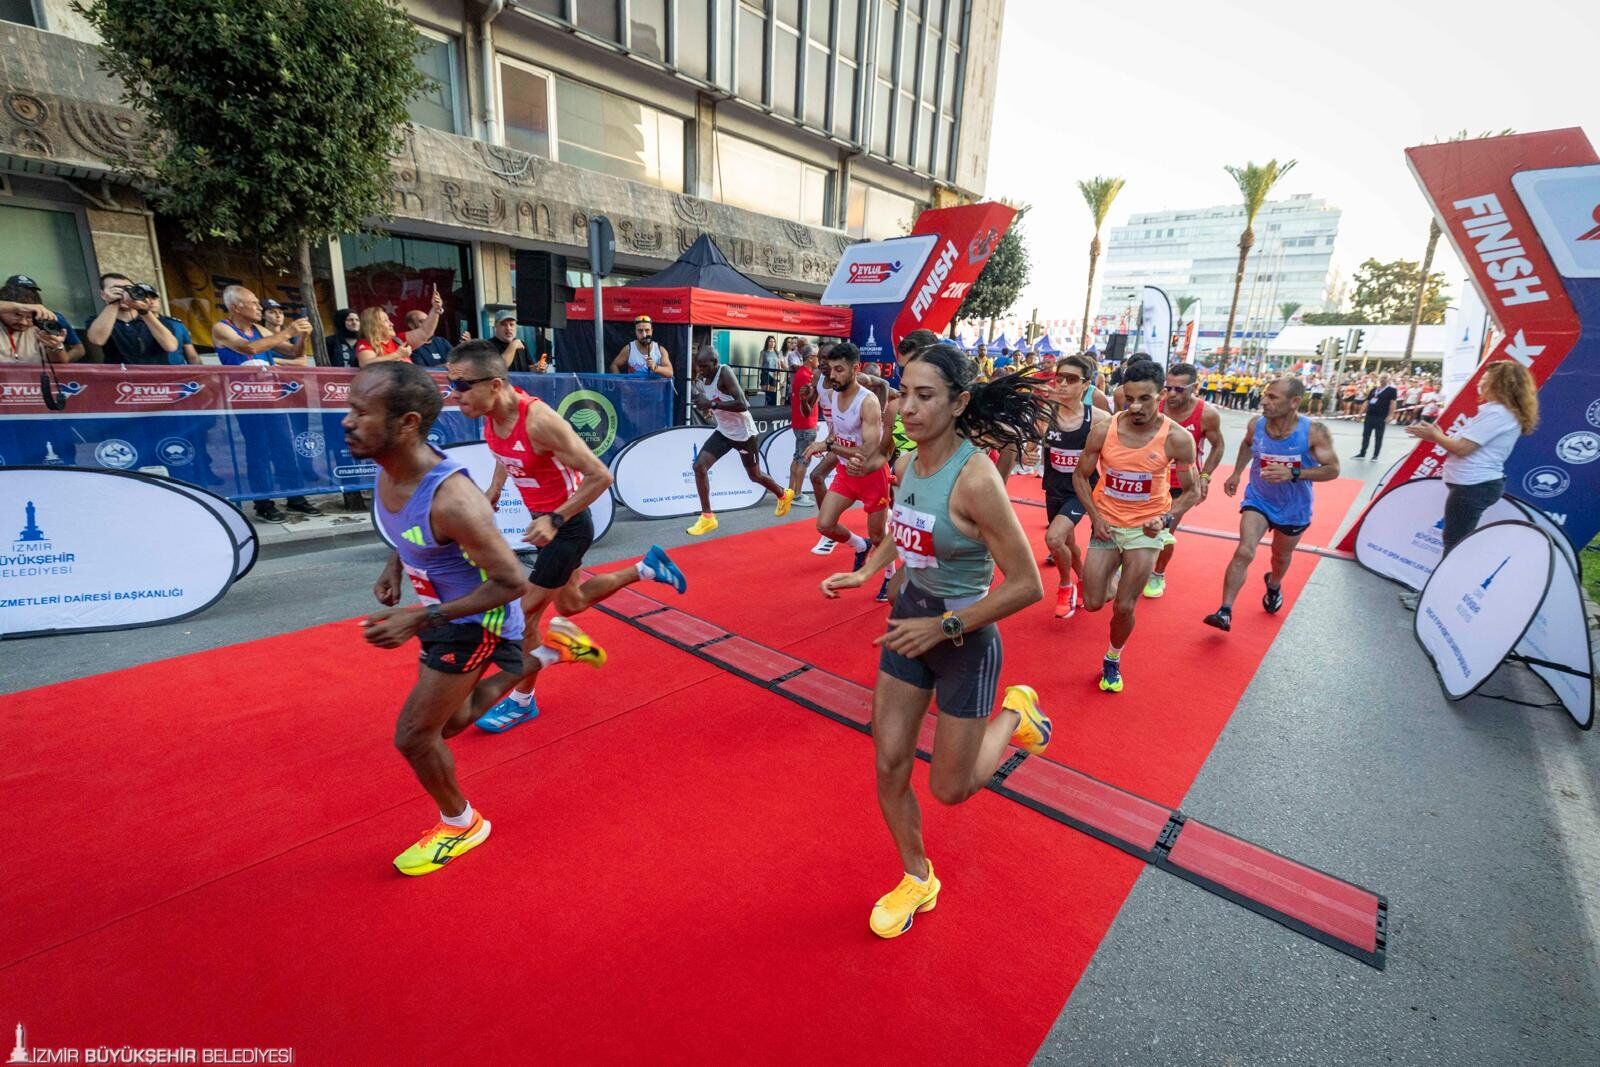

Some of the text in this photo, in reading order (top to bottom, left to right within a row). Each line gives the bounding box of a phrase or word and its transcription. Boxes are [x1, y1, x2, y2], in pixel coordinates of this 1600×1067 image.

[1453, 192, 1550, 307] FINISH
[911, 240, 959, 322] FINISH
[941, 282, 971, 298] 21K
[1111, 477, 1144, 493] 1778
[12, 542, 52, 552] İZMİR
[64, 591, 112, 603] DAİRESİ
[115, 588, 183, 600] BAŞKANLIĞI
